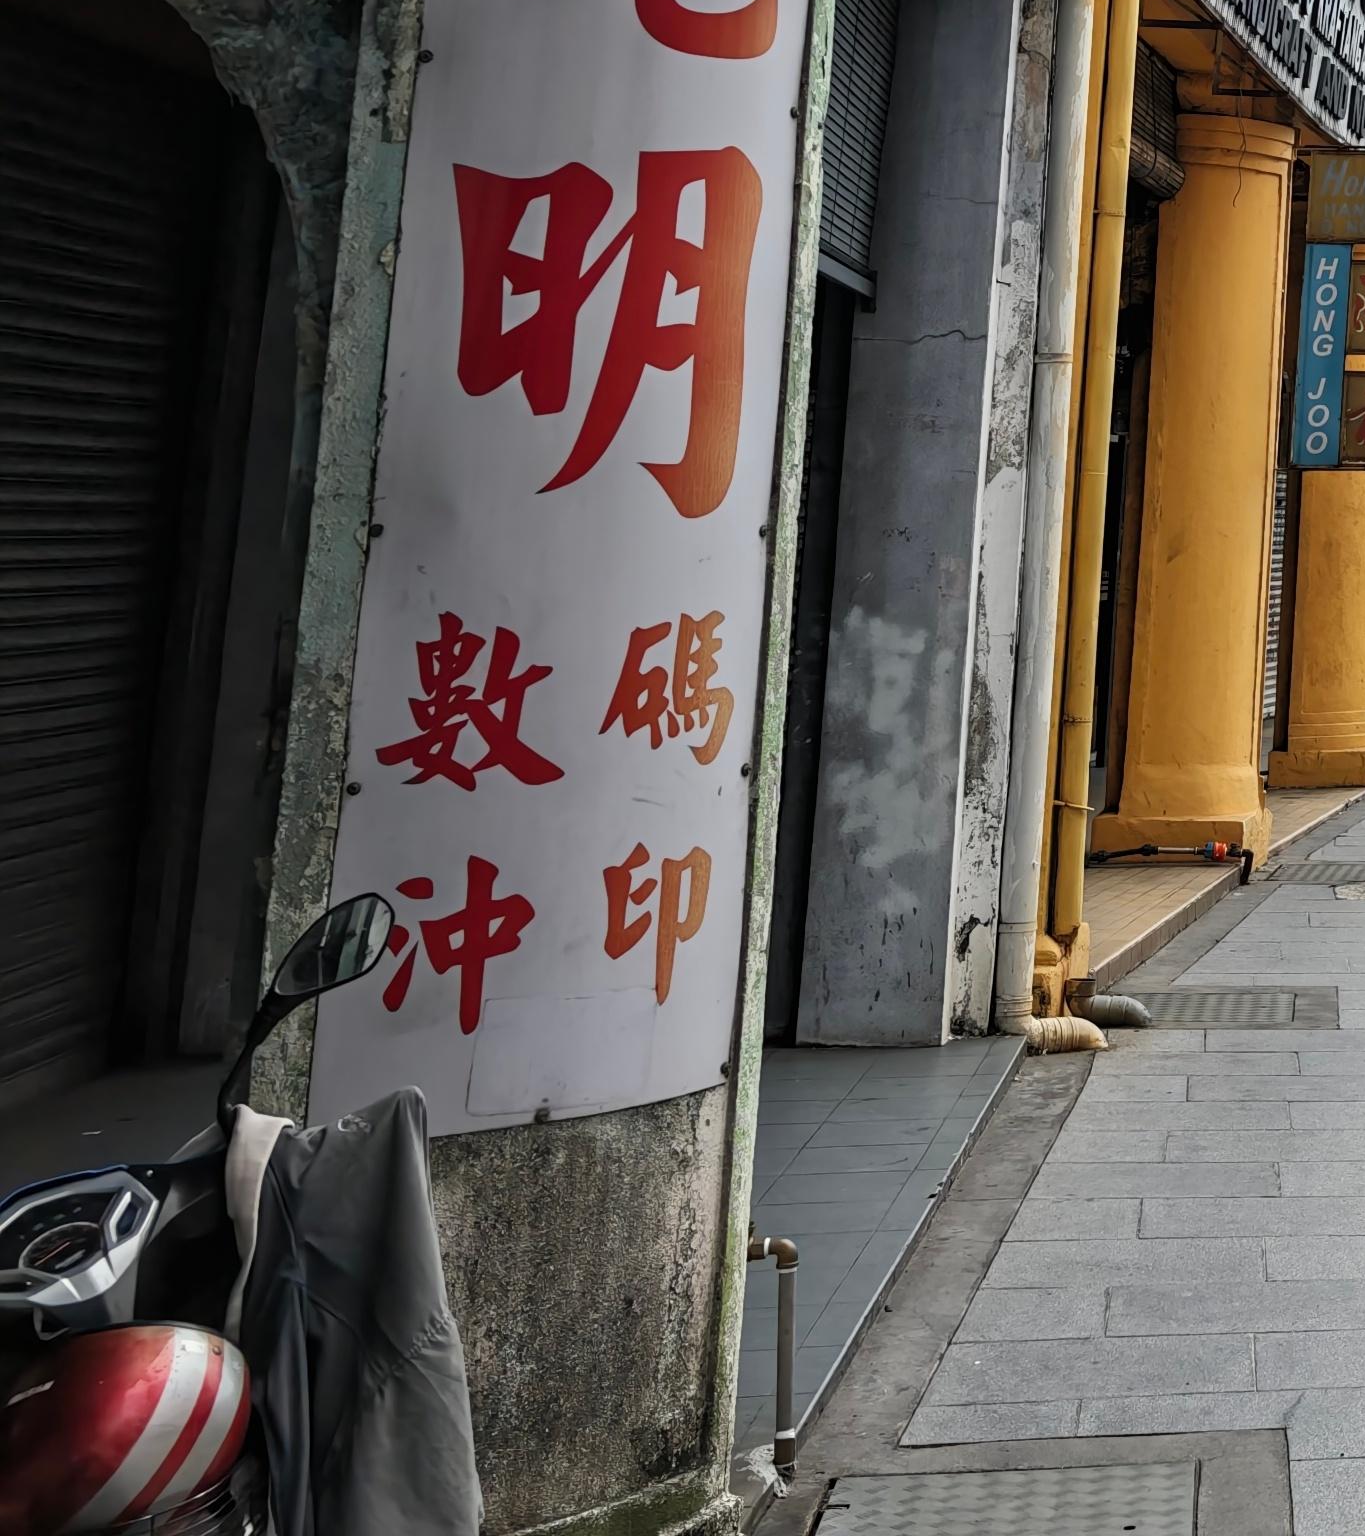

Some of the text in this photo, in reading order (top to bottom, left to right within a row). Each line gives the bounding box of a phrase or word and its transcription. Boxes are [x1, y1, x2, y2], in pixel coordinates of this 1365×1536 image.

[1314, 56, 1350, 120] AND
[1306, 257, 1338, 455] HONG JOO
[376, 611, 734, 791] 數碼
